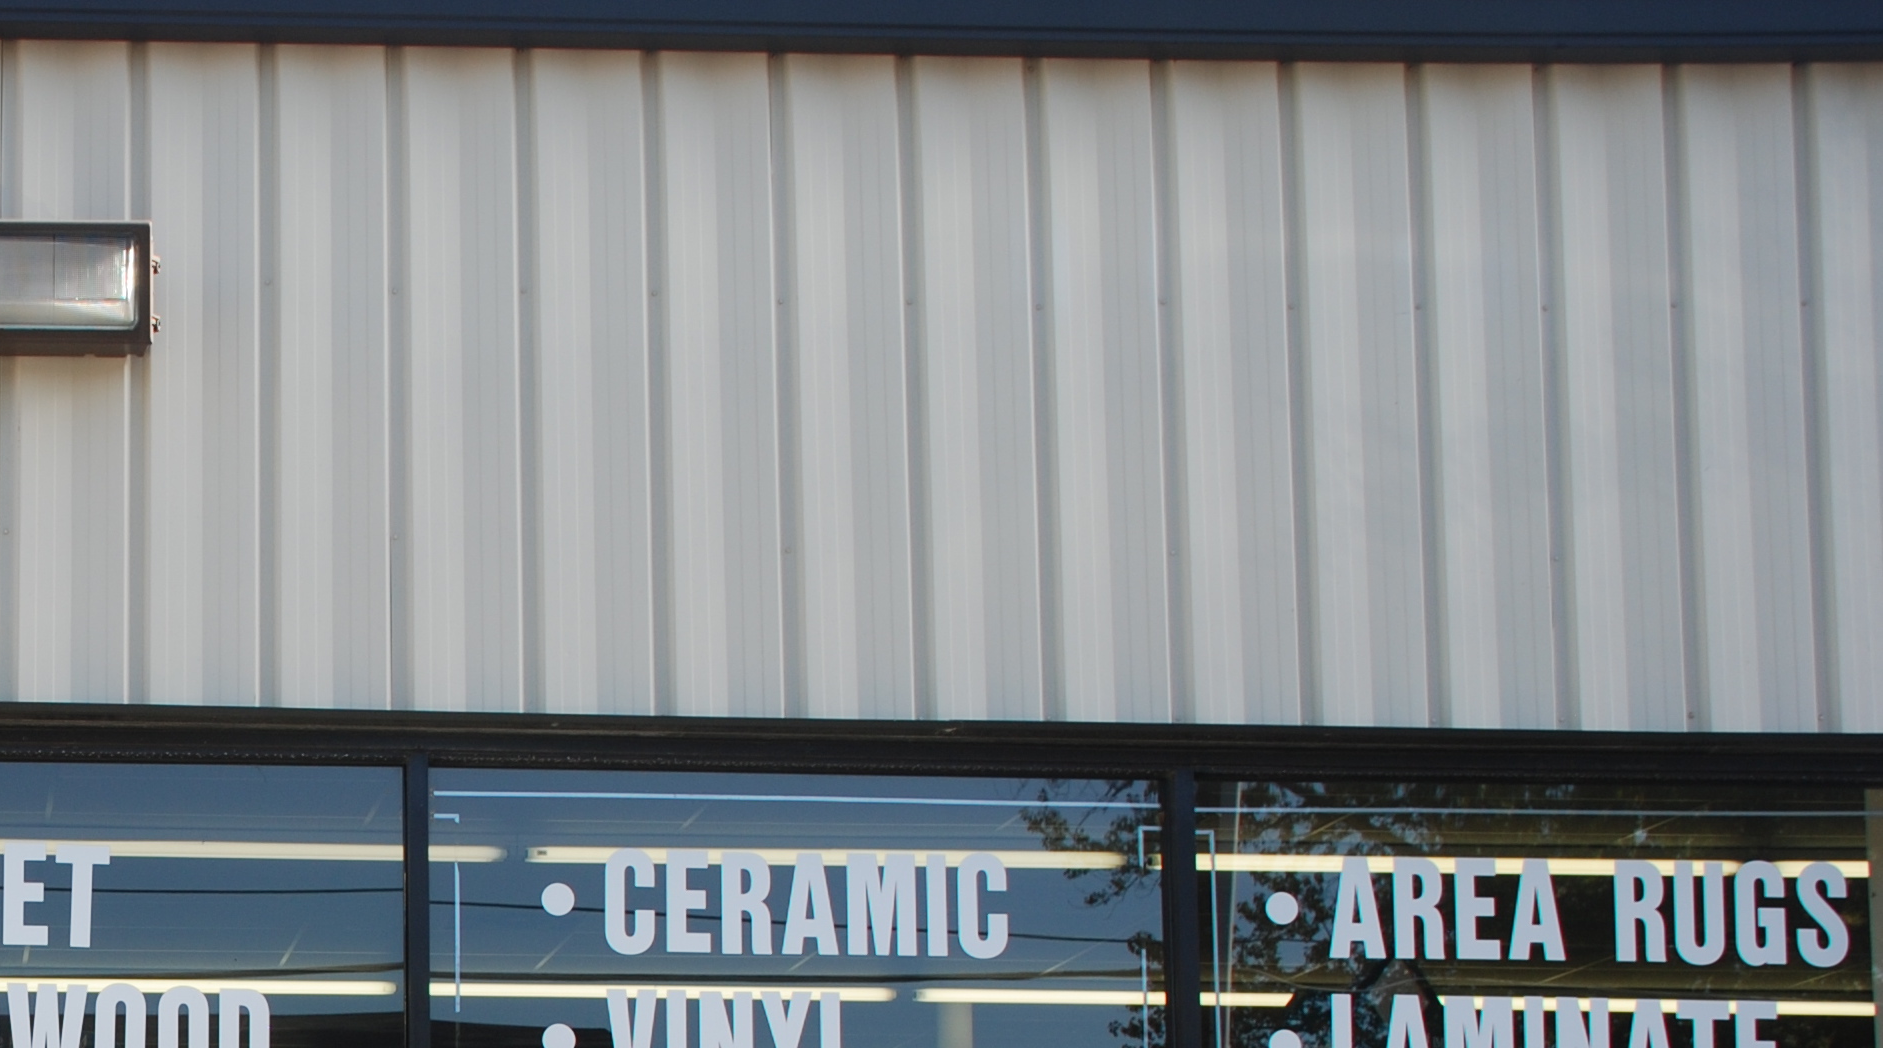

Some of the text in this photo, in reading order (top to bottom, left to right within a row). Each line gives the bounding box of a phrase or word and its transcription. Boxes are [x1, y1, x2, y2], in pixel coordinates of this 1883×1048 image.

[604, 848, 1009, 959] CERAMIC
[1329, 856, 1850, 967] AREA RUGS
